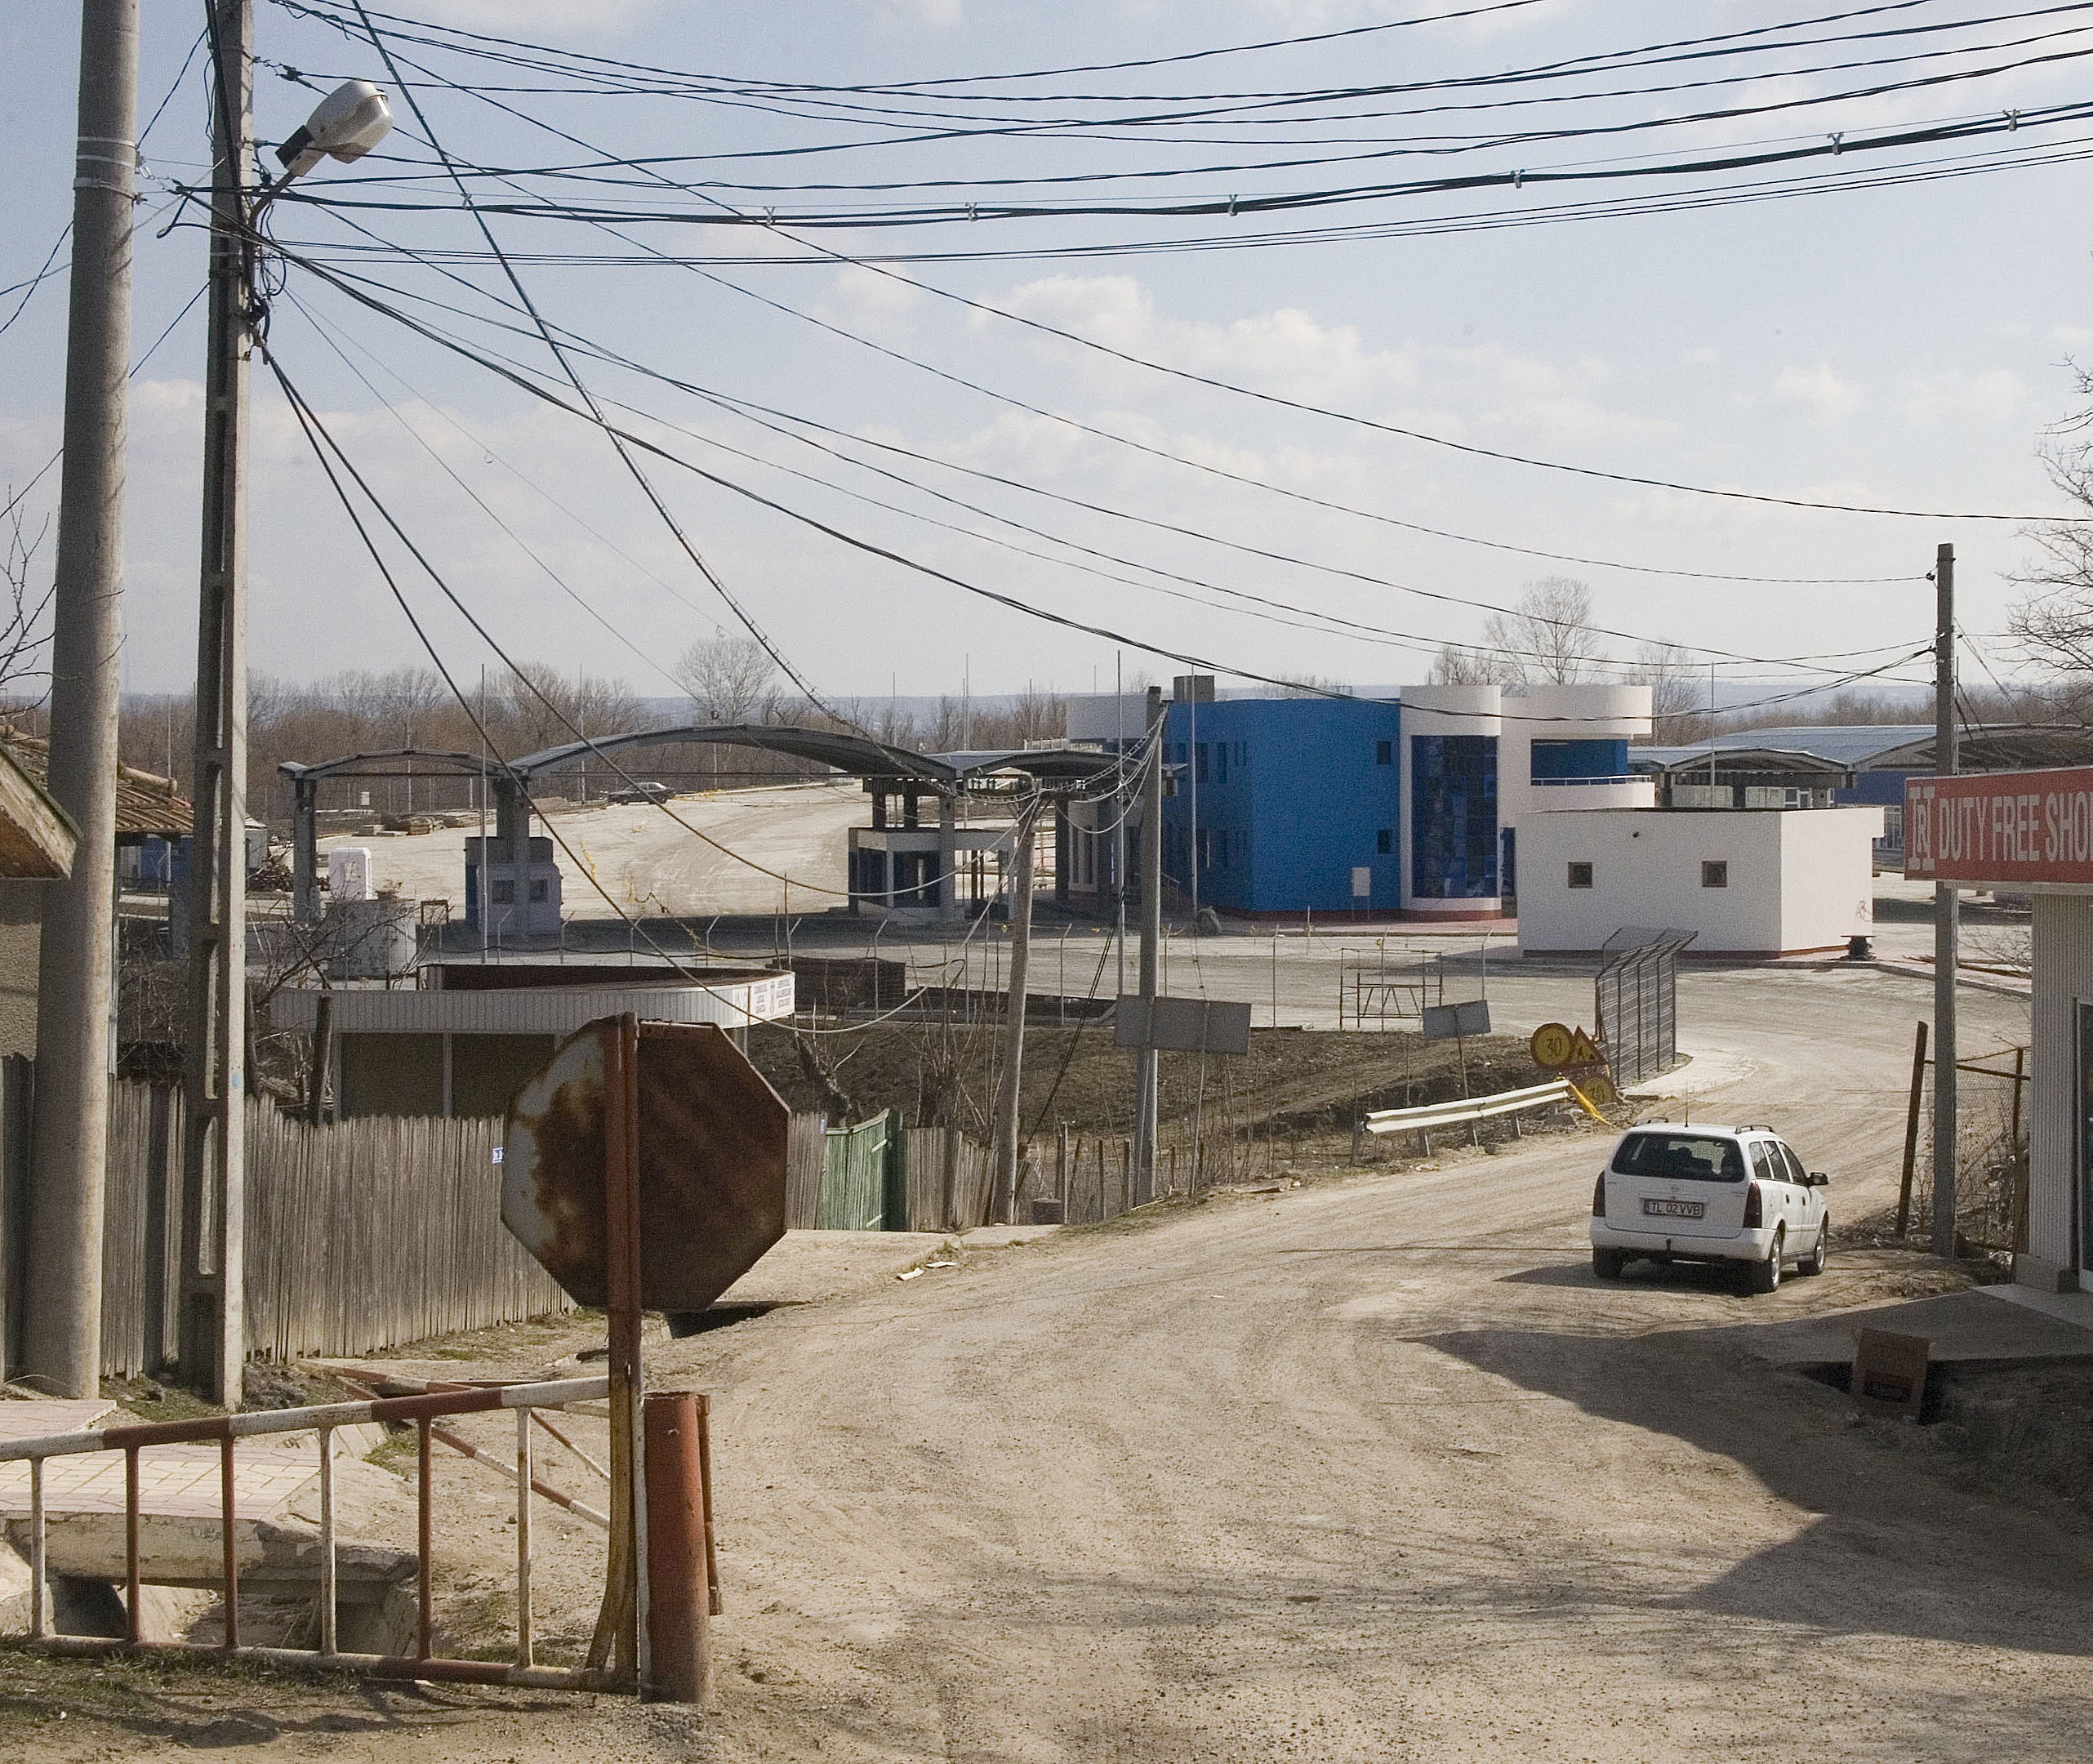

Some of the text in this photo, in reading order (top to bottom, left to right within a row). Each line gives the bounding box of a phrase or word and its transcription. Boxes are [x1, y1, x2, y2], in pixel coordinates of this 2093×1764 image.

[1939, 796, 1988, 860] DUTY
[1992, 795, 2040, 862] FREE
[1546, 1036, 1562, 1058] 30
[1651, 1202, 1663, 1213] TL
